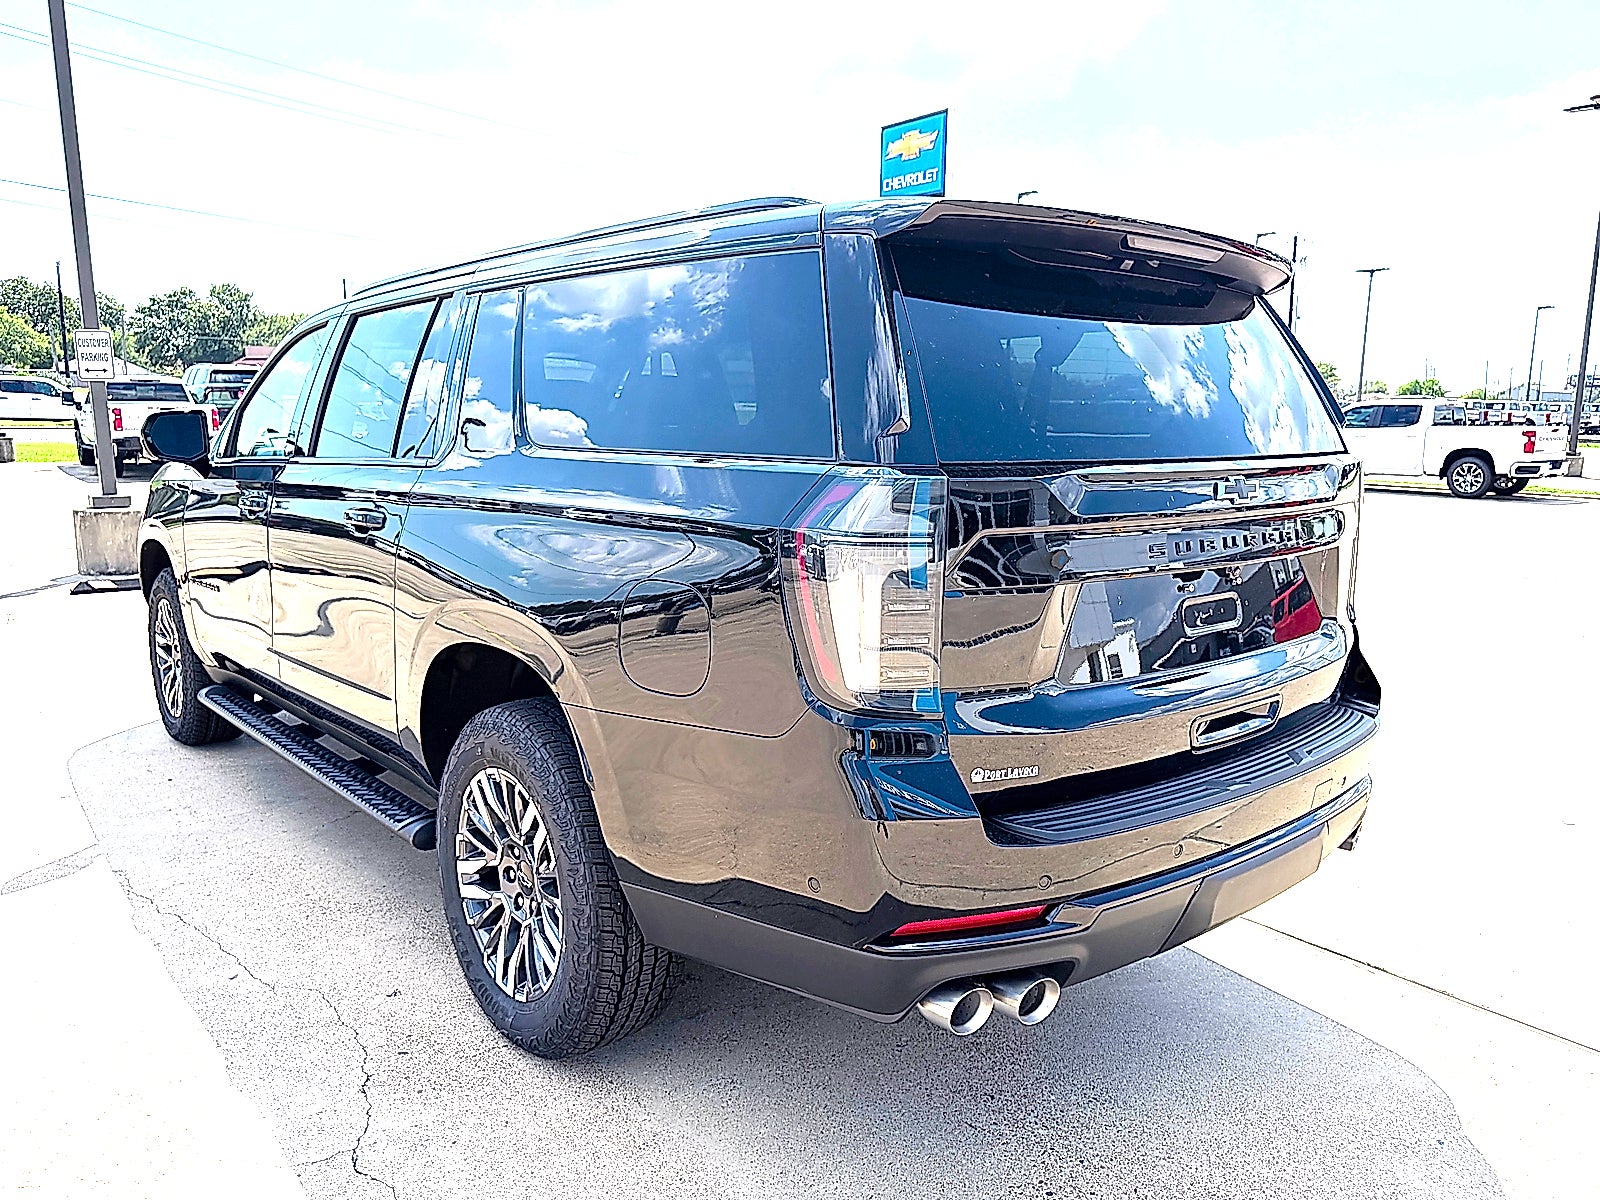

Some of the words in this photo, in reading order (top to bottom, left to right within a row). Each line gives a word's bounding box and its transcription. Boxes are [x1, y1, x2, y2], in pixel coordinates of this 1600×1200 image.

[883, 168, 938, 191] CHEVROLET
[78, 338, 109, 347] CUSTOMER
[81, 353, 109, 362] PARKING
[1148, 526, 1309, 560] SUBURBAN
